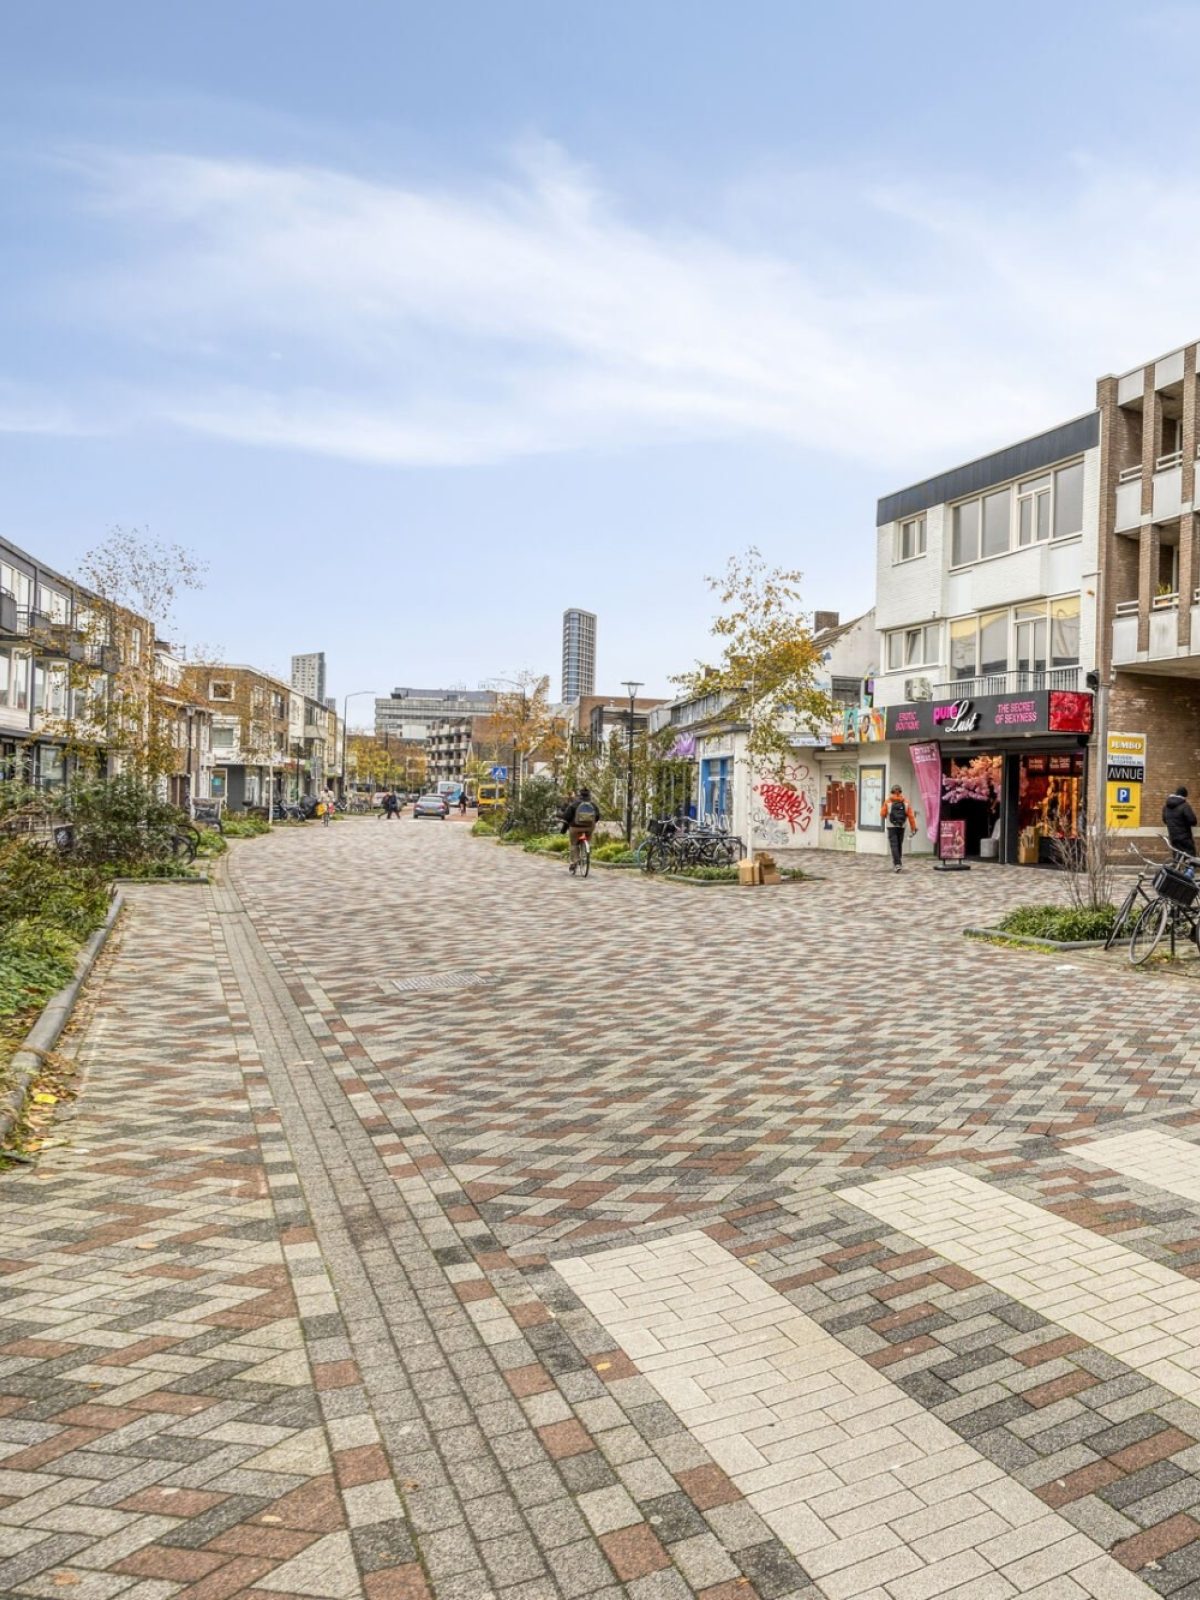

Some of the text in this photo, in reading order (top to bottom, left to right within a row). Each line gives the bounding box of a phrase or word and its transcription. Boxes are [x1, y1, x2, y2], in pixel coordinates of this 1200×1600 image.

[998, 701, 1036, 714] THE SECRET
[933, 705, 958, 726] pure
[944, 699, 977, 732] Lust
[995, 712, 1037, 724] OF SEXYNESS
[1111, 741, 1142, 749] JUMBO
[1119, 789, 1127, 801] P
